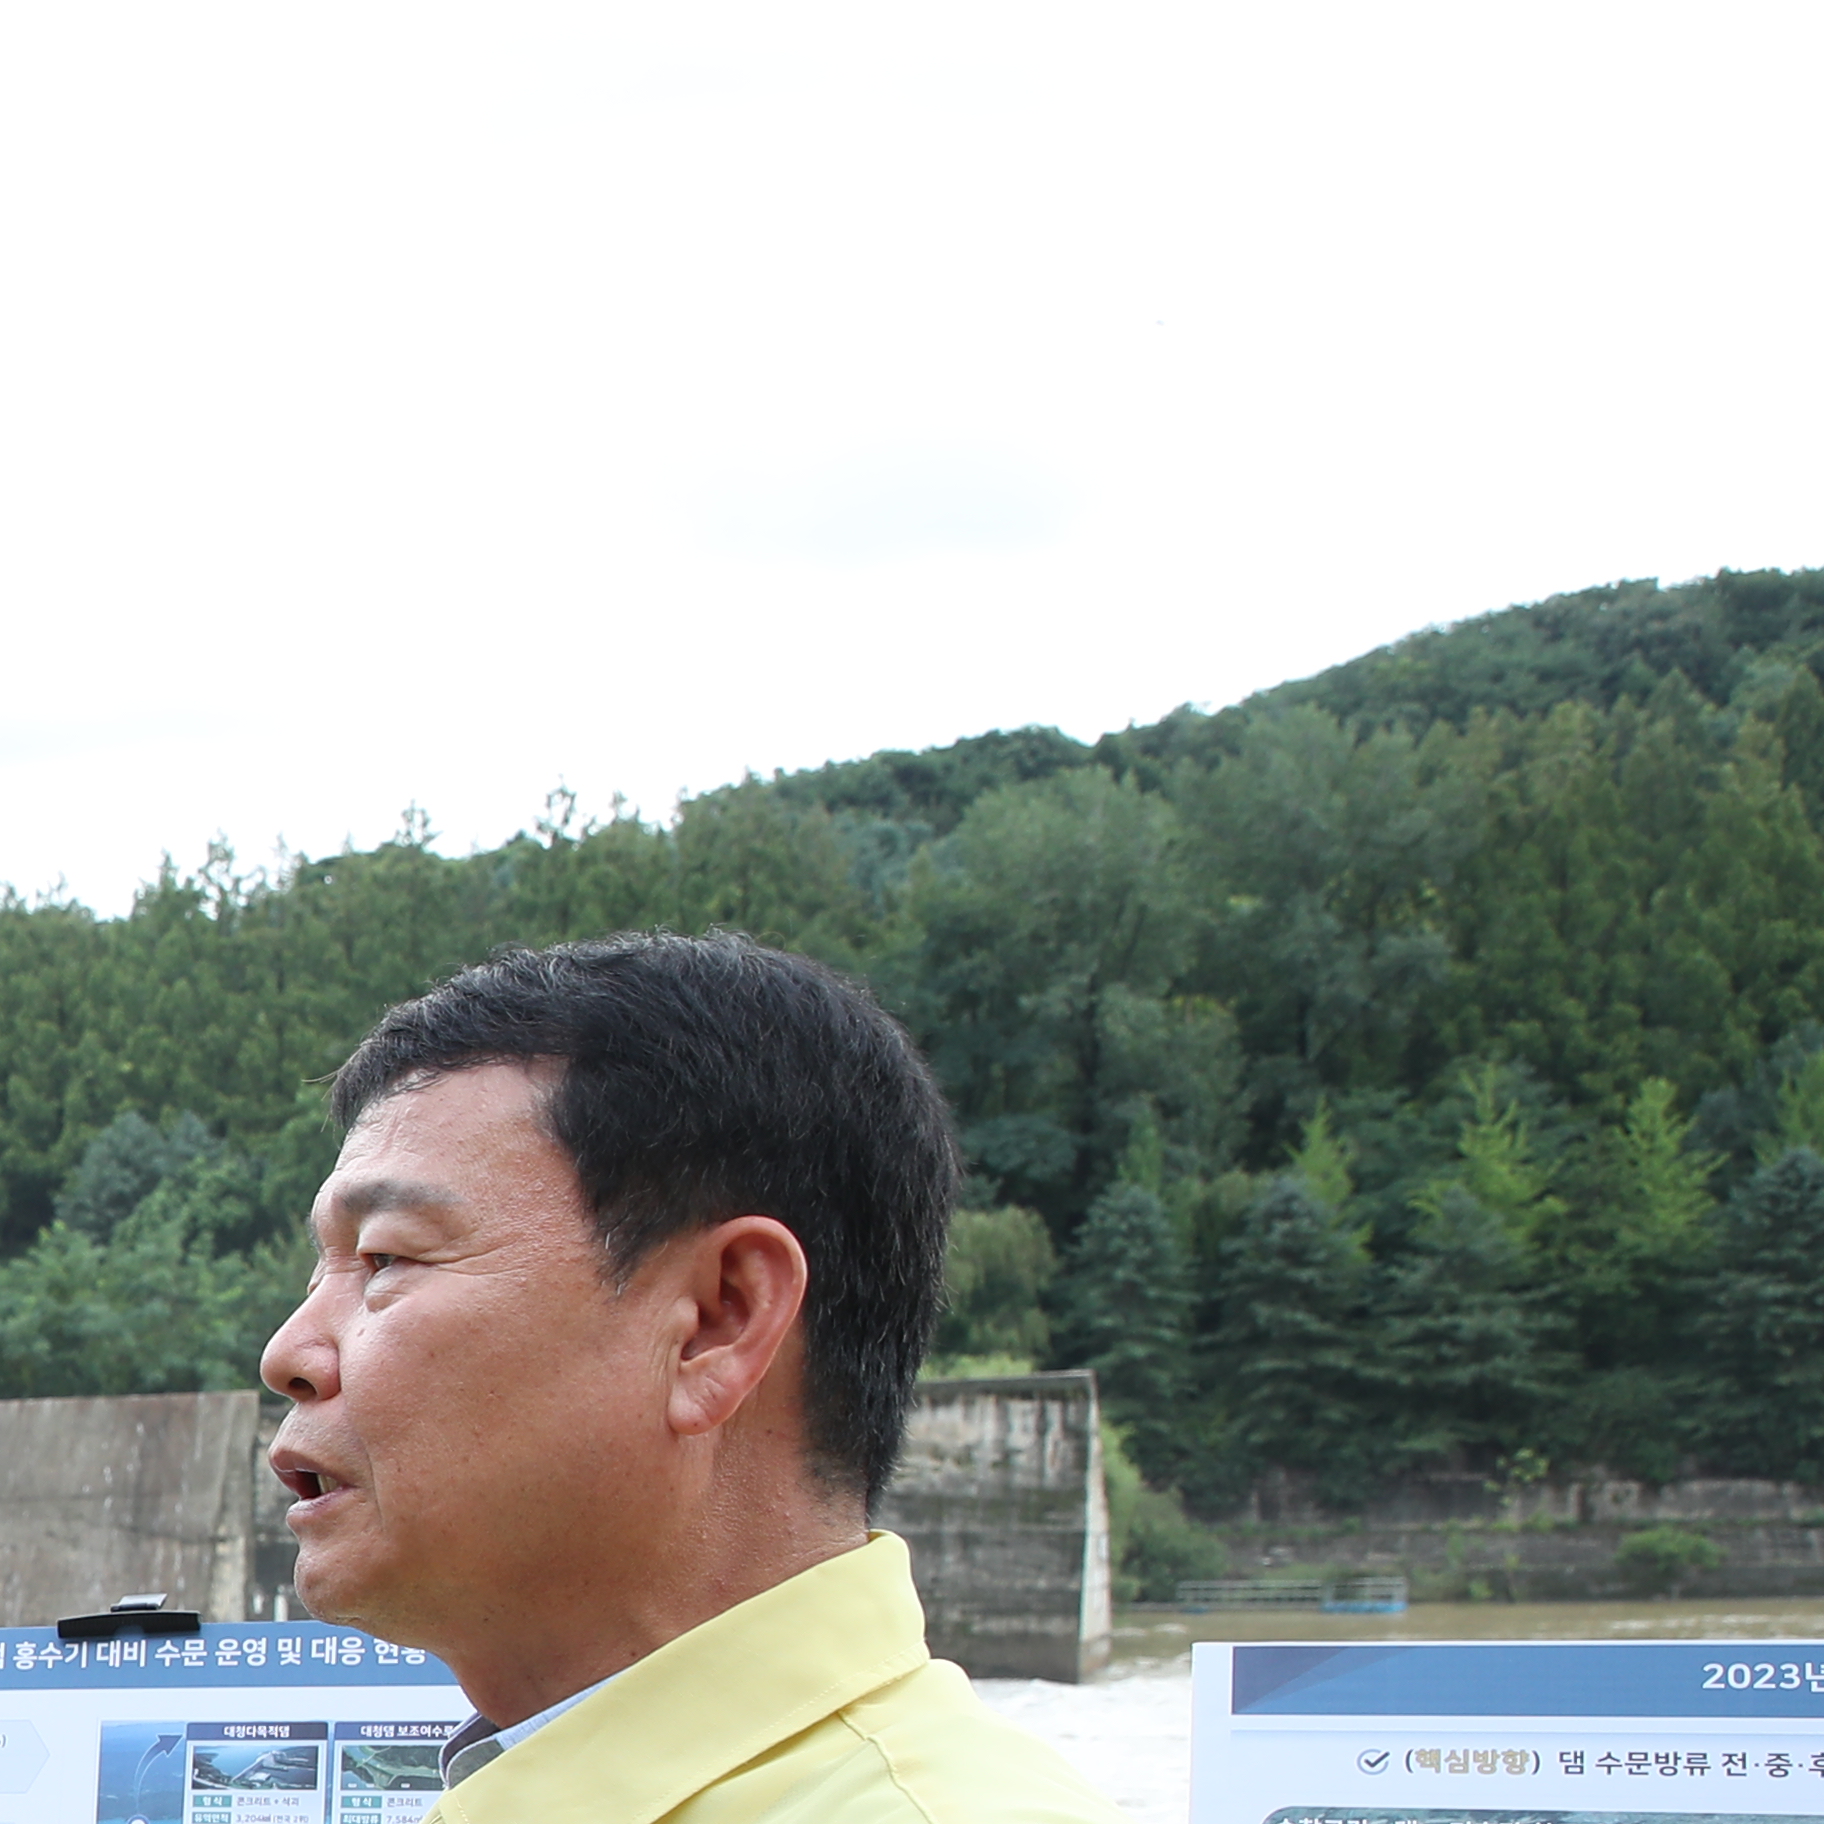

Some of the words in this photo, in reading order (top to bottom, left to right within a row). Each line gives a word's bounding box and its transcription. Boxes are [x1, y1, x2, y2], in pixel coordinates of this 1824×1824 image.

[12, 1639, 88, 1670] 홍수기
[96, 1638, 146, 1668] 대비
[155, 1637, 205, 1667] 수문
[215, 1636, 266, 1667] 운영
[276, 1636, 302, 1666] 및
[310, 1635, 366, 1666] 대응
[224, 1725, 290, 1739] 대청다목적댐
[360, 1725, 394, 1738] 대청댐
[1404, 1747, 1541, 1776] (핵심방향)
[1559, 1751, 1585, 1776] 댐
[1594, 1751, 1711, 1777] 수문방류
